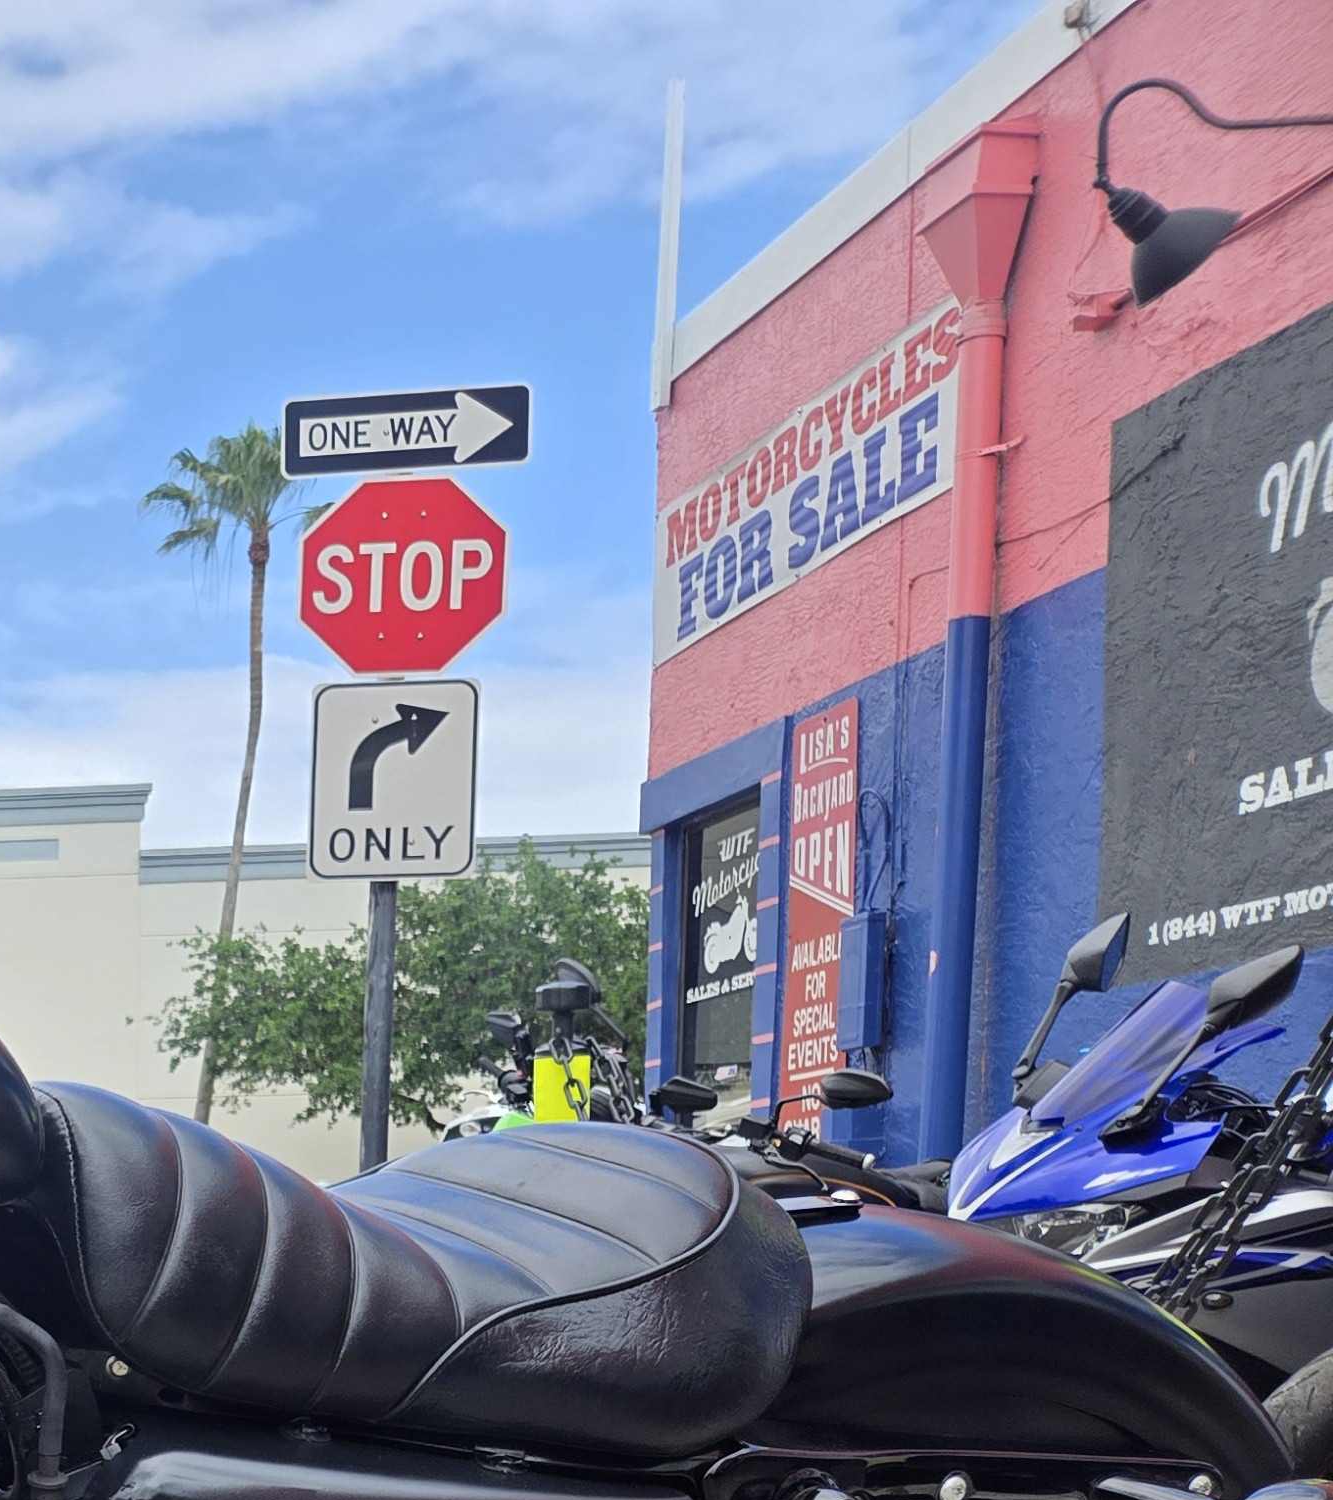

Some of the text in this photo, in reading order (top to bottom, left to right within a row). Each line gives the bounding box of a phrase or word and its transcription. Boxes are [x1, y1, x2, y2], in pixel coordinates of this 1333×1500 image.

[308, 414, 457, 451] ONE WAY
[666, 307, 961, 569] MOTORCYCLES
[677, 391, 939, 642] FOR SALE
[312, 538, 494, 614] STOP
[799, 715, 850, 775] LISA'S
[793, 769, 854, 825] BACKYARD
[329, 825, 454, 862] ONLY
[717, 827, 756, 863] WTF
[794, 820, 850, 898] OPEN
[1148, 882, 1333, 946] 1 (844) WTF MO
[686, 980, 720, 1004] SALES
[805, 970, 826, 1002] FOR
[793, 1002, 835, 1038] SPECIAL
[788, 1034, 838, 1071] EVENTS
[802, 1082, 821, 1113] NO
